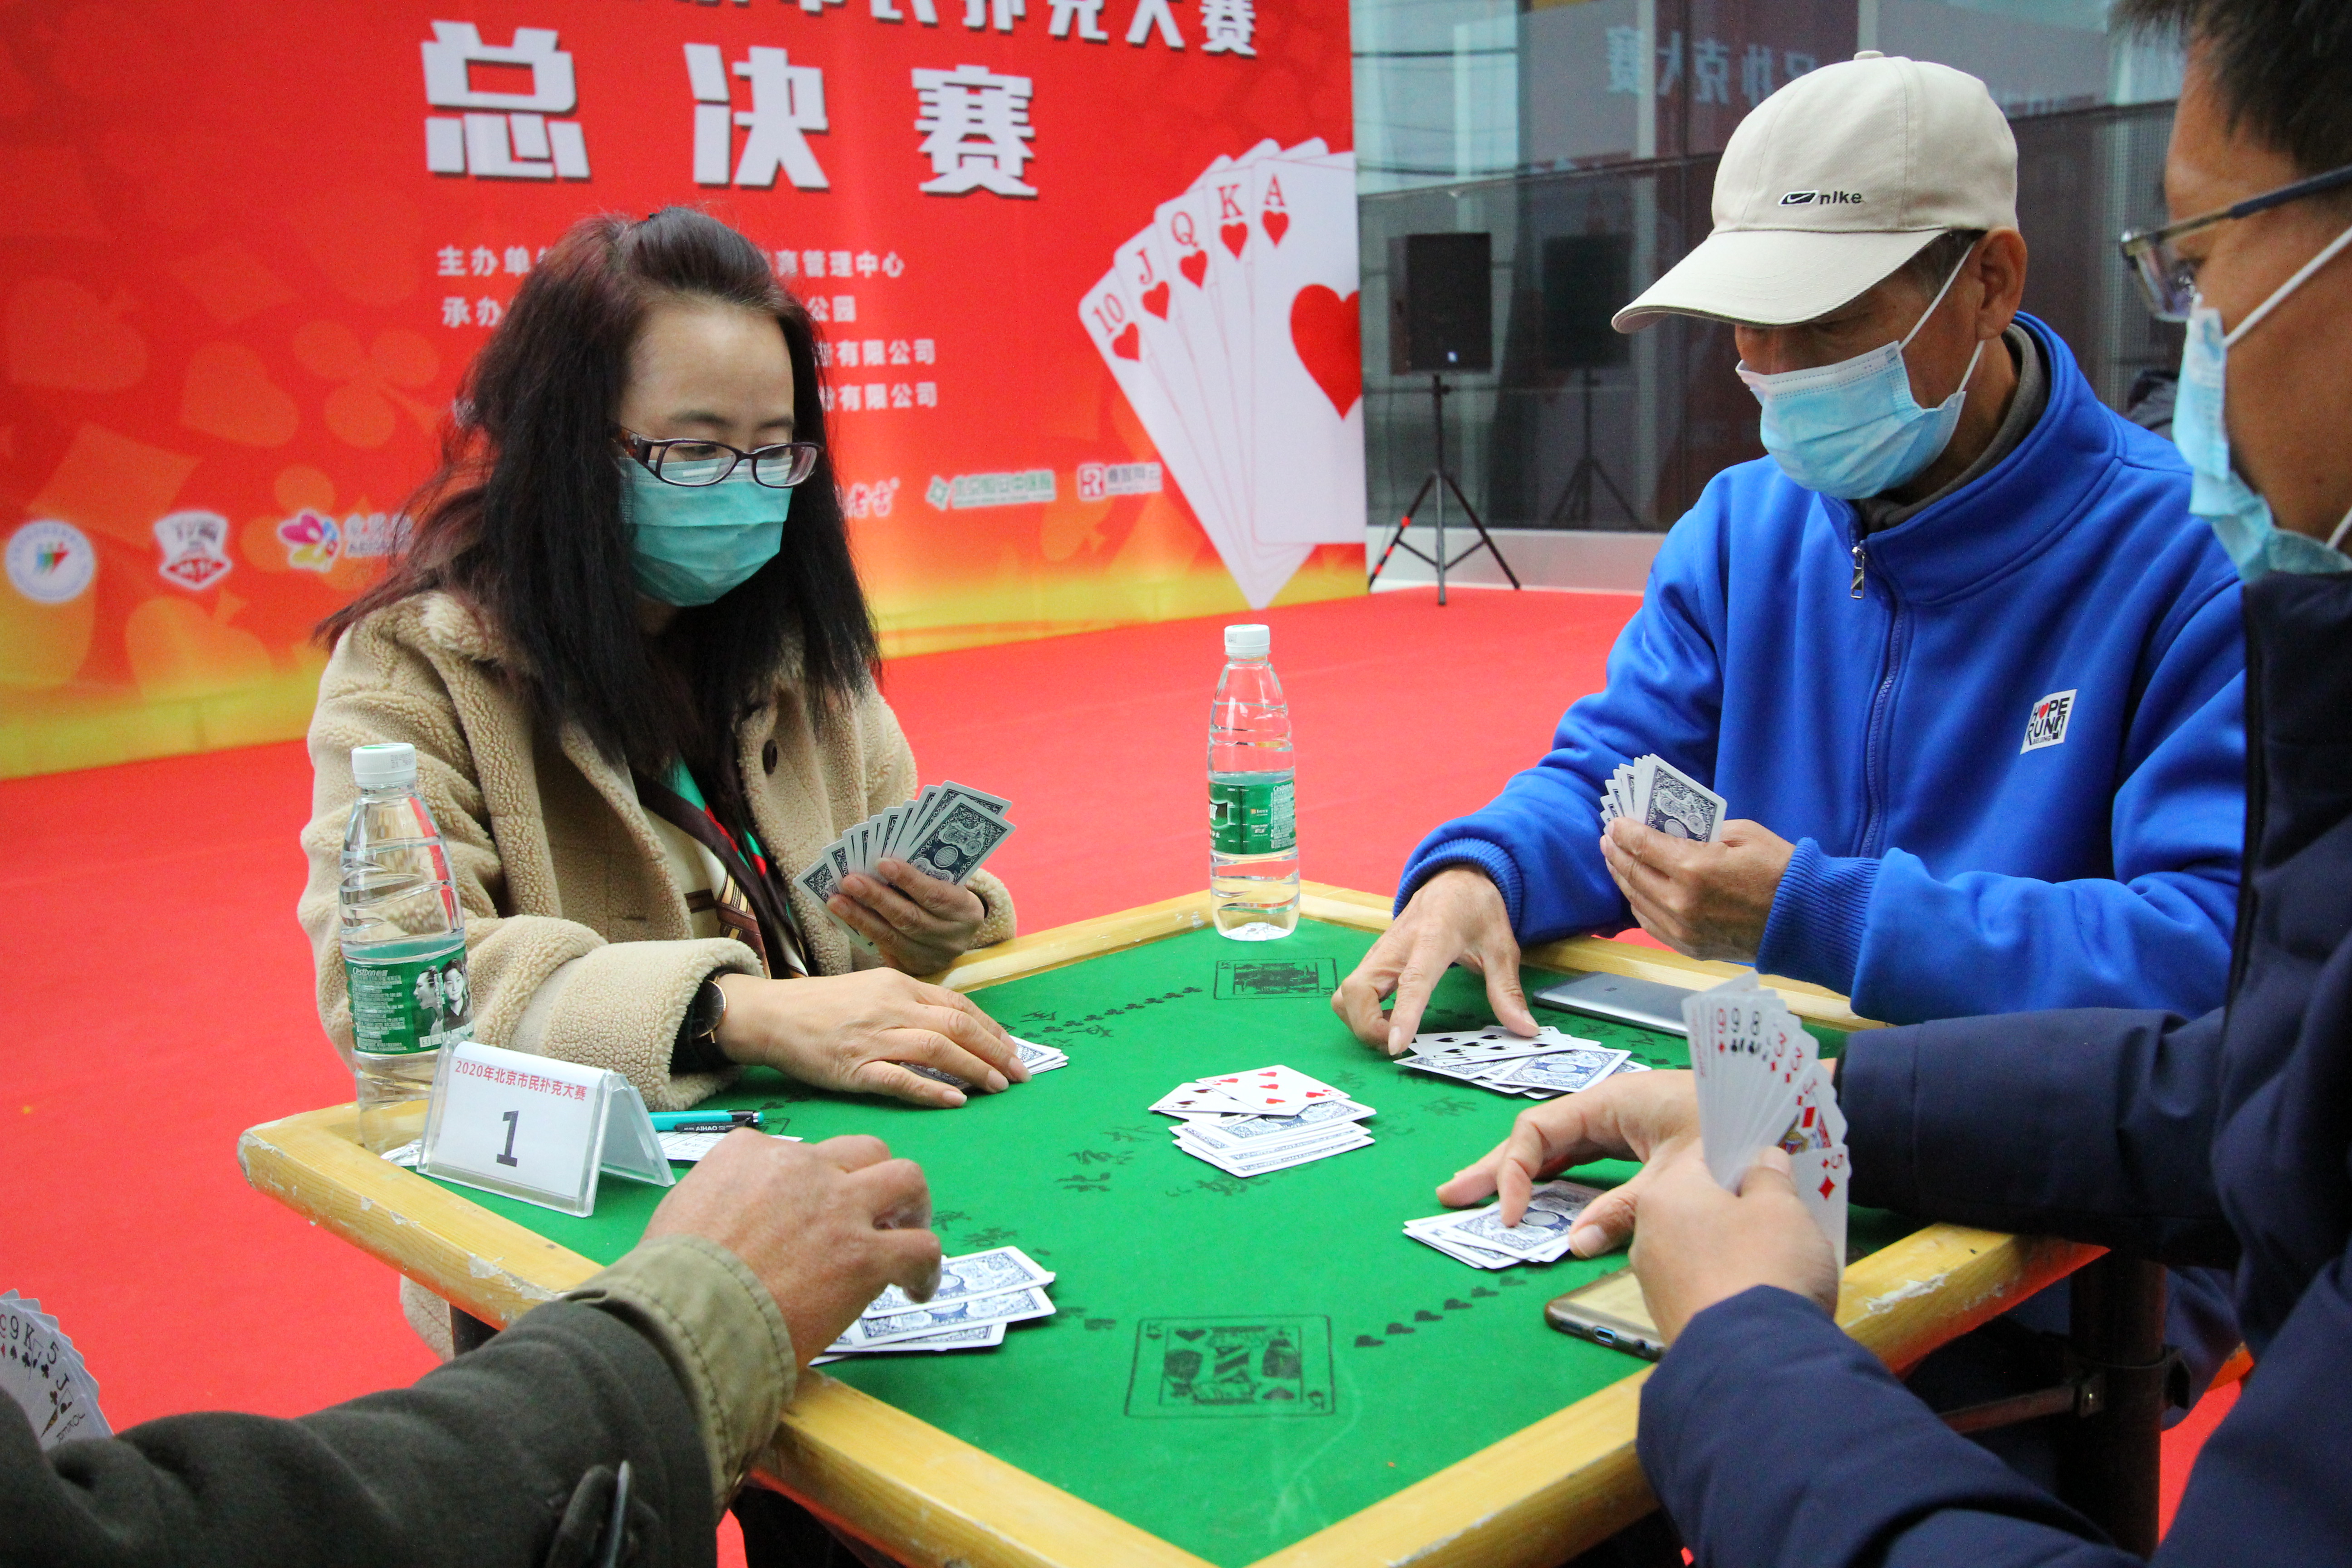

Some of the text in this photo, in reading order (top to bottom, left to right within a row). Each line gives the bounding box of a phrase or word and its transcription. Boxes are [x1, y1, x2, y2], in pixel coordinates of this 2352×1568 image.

[421, 20, 1038, 197] 总决赛
[1217, 183, 1243, 220] K
[1264, 174, 1285, 206] A
[1171, 211, 1200, 248] Q
[437, 245, 546, 277] 主办单
[1135, 248, 1154, 284] J
[1092, 293, 1125, 337] 10
[1716, 1007, 1762, 1036] 9 9 8
[455, 1061, 588, 1101] 2020年北京市民扑克大赛
[496, 1110, 519, 1168] 1
[10, 1315, 19, 1339] 9
[24, 1323, 35, 1351] K
[47, 1341, 59, 1365] 5
[56, 1373, 69, 1391] J
